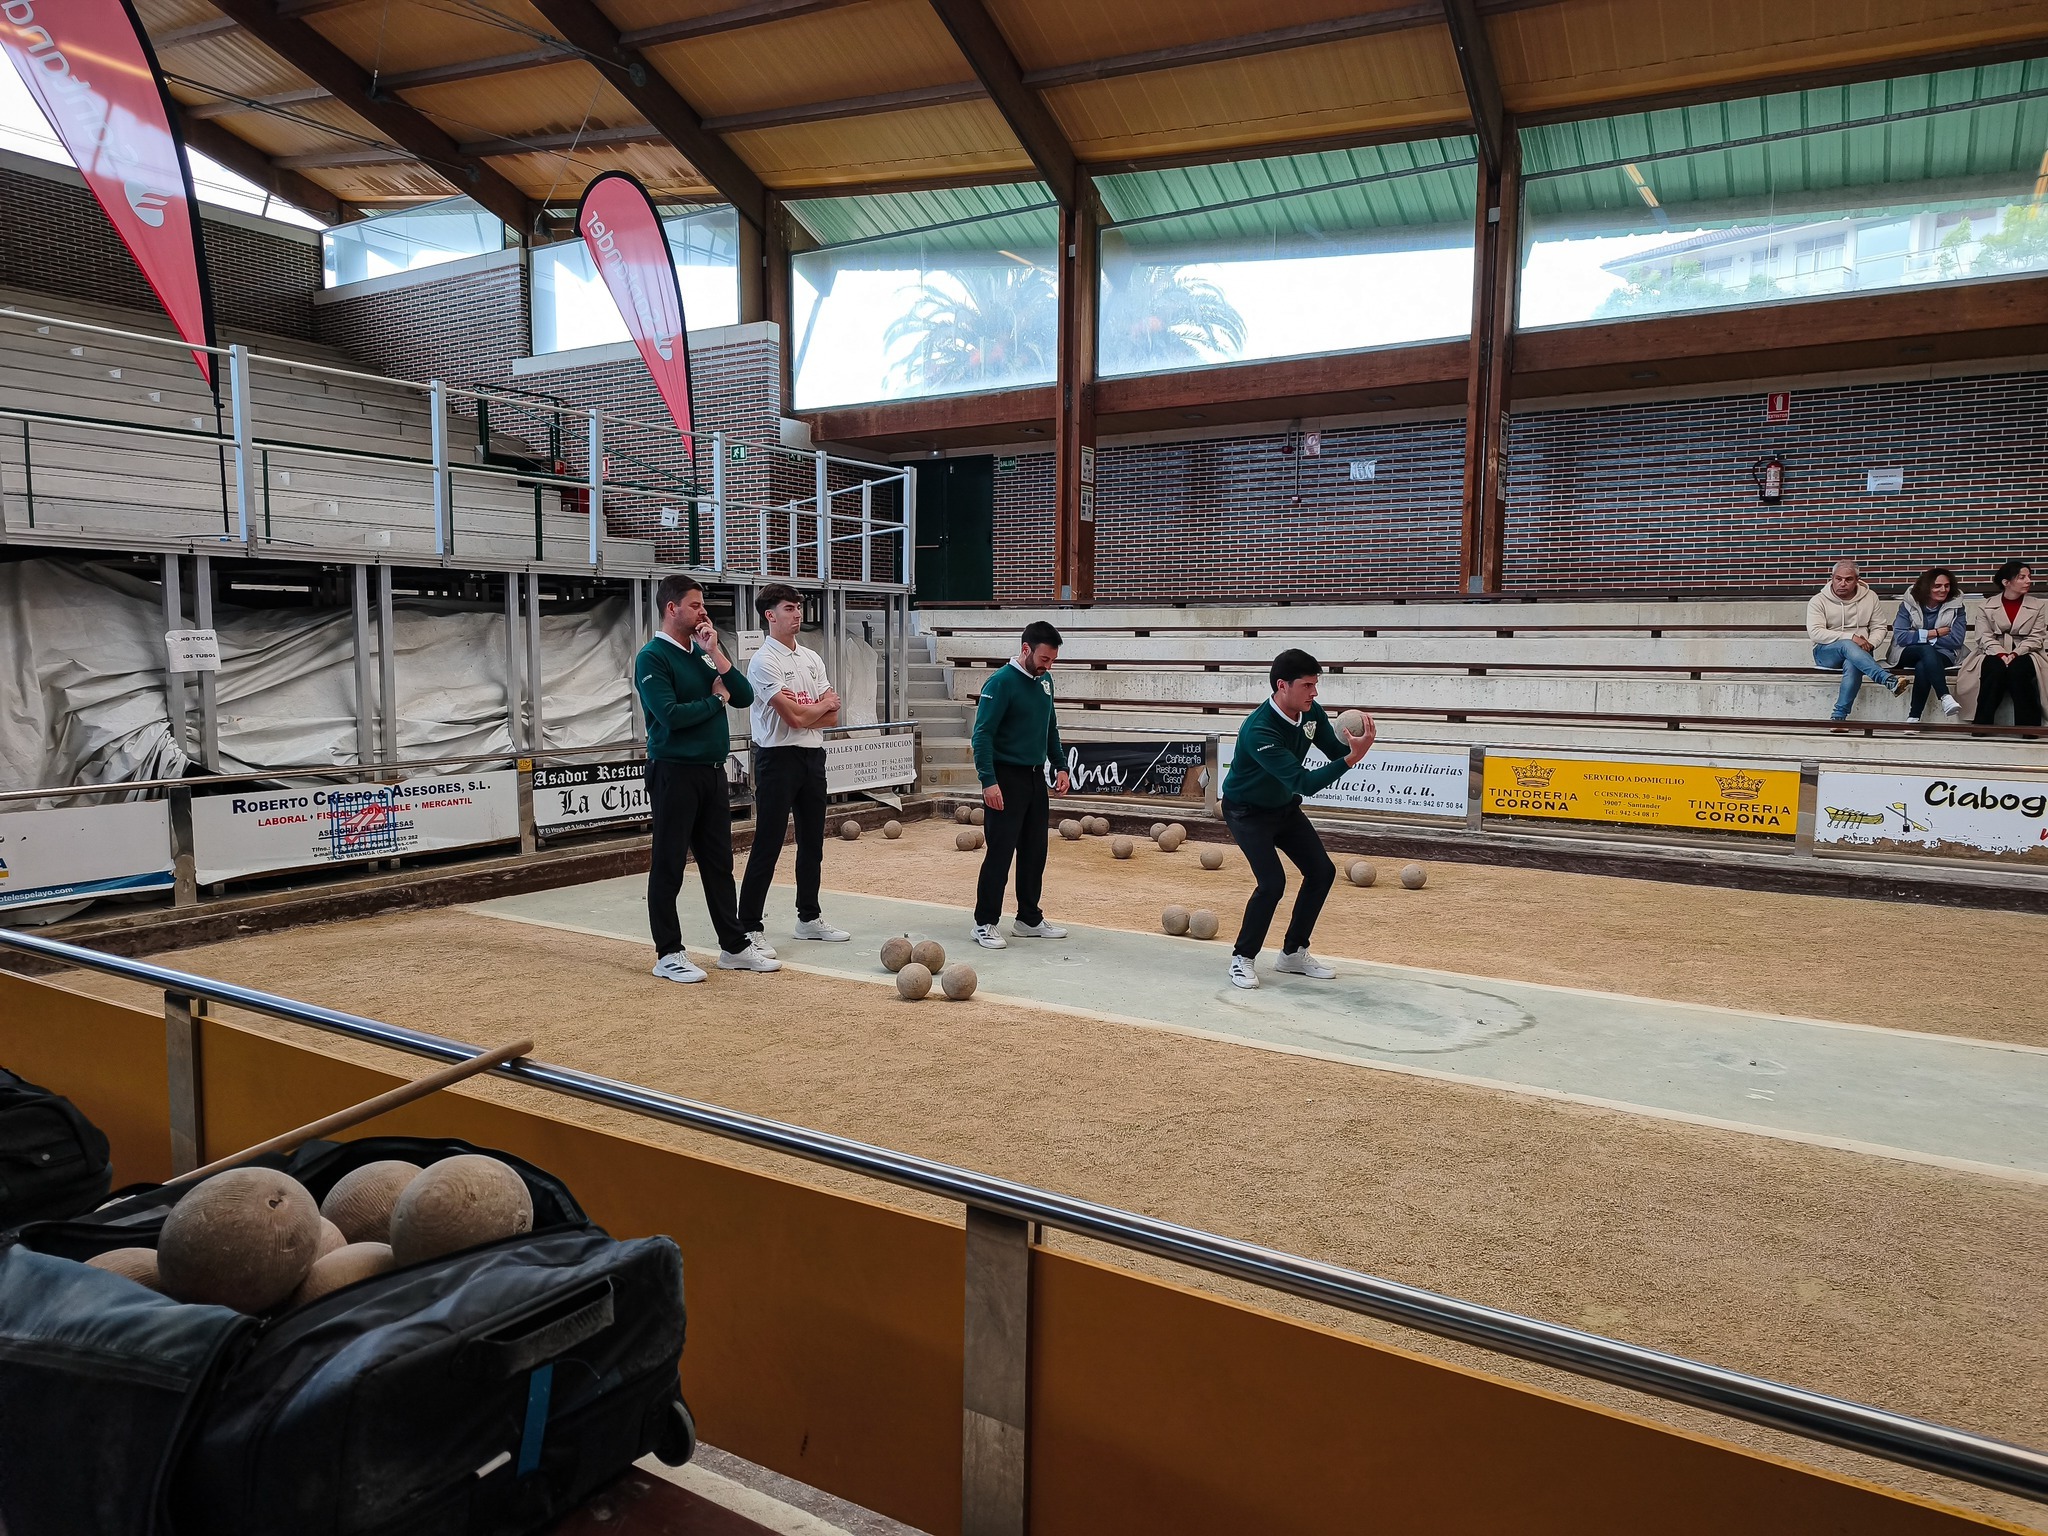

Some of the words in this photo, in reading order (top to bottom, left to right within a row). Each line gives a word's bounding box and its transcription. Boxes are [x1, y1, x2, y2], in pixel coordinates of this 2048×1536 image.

[854, 744, 864, 753] DE
[865, 739, 913, 751] CONSTRUCCION
[1182, 743, 1201, 753] Hotel
[1381, 761, 1464, 776] Inmobiliarias
[533, 769, 589, 787] Asador
[1583, 773, 1625, 782] SERVICIO
[1634, 776, 1685, 785] DOMICILIO
[378, 789, 386, 799] &
[393, 782, 465, 798] ASESORES,
[468, 780, 491, 791] S.L.
[1388, 784, 1435, 797] s.a.u.
[1489, 788, 1578, 801] TINTORERIA
[1601, 791, 1641, 799] CISNEROS,
[558, 789, 590, 816] La
[1376, 796, 1384, 804] 63
[1423, 800, 1434, 808] 942
[1446, 801, 1454, 809] 50
[1455, 802, 1463, 810] 84
[1495, 798, 1569, 811] CORONA
[1627, 801, 1661, 809] Santander
[1924, 780, 2047, 818] Ciabog
[258, 814, 307, 827] LABORAL
[316, 809, 352, 820] FISCAL
[360, 803, 411, 815] CONTABLE
[421, 797, 472, 809] MERCANTIL
[1688, 800, 1791, 815] TINTORERIA
[373, 820, 414, 831] EMPRESAS
[1695, 811, 1780, 826] CORONA
[347, 850, 375, 859] BERANGA
